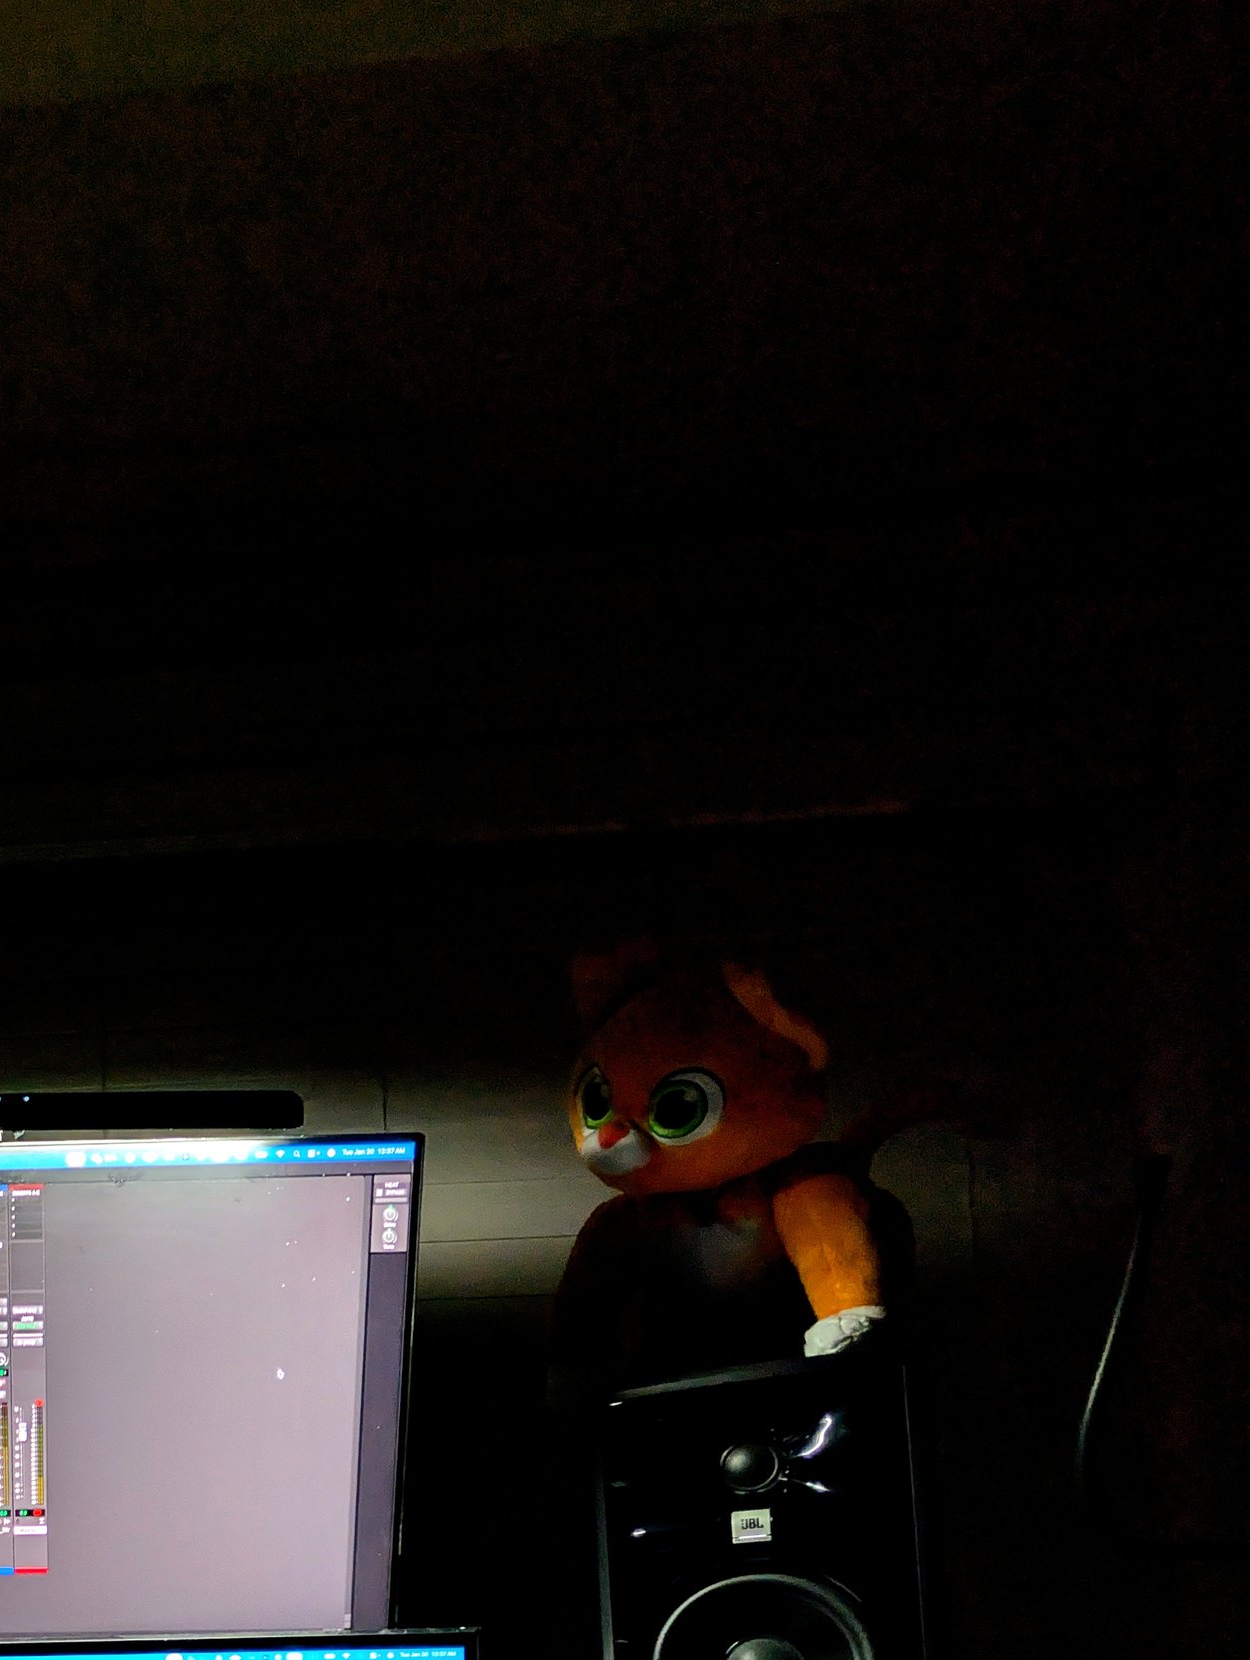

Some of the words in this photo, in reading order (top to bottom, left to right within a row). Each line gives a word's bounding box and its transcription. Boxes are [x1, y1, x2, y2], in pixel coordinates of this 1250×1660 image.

[366, 1147, 375, 1155] 20
[377, 1147, 395, 1155] 12:37
[741, 1517, 764, 1530] JBL
